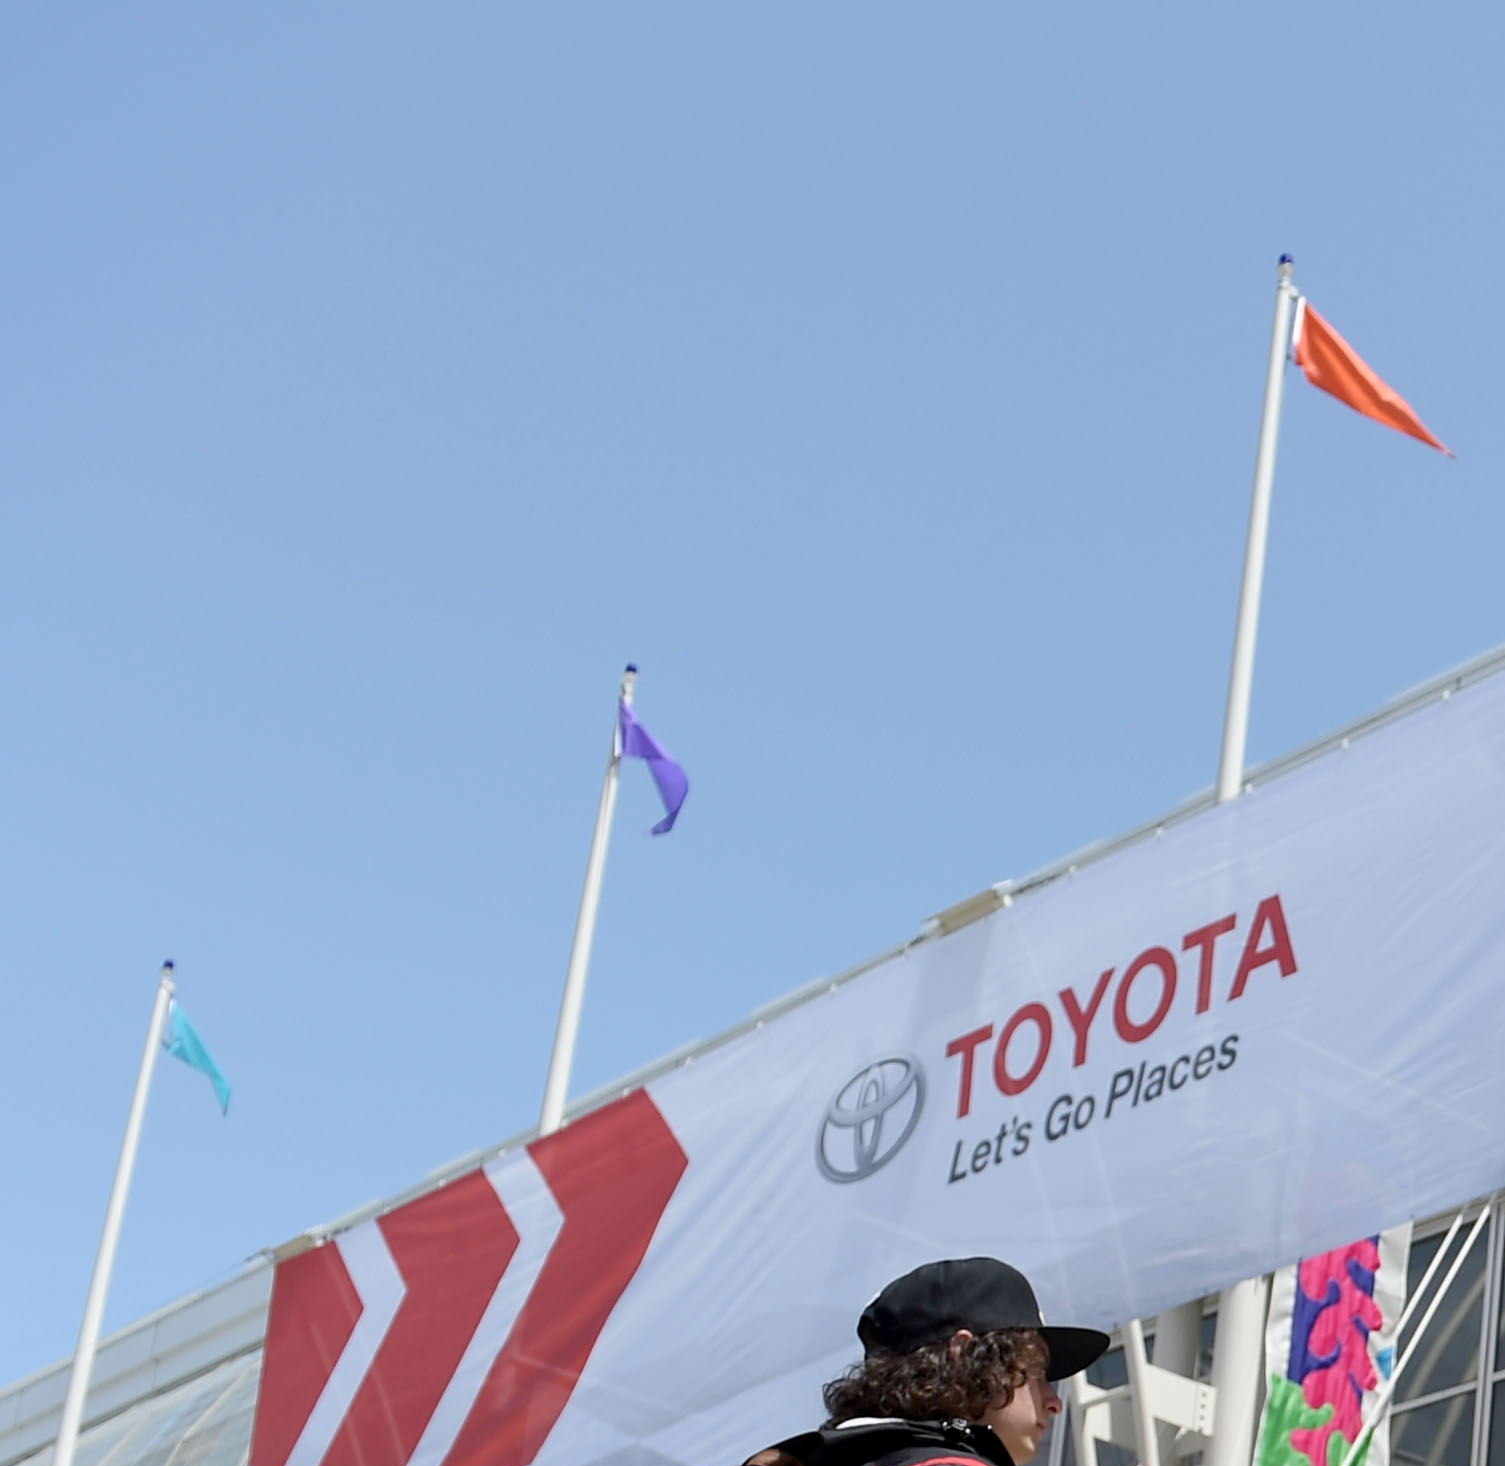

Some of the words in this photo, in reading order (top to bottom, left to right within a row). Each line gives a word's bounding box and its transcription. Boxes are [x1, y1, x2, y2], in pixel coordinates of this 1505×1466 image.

[945, 894, 1300, 1120] TOYOTA
[947, 1117, 1030, 1185] Let's
[1044, 1094, 1096, 1142] Go
[1104, 1034, 1240, 1119] Places
